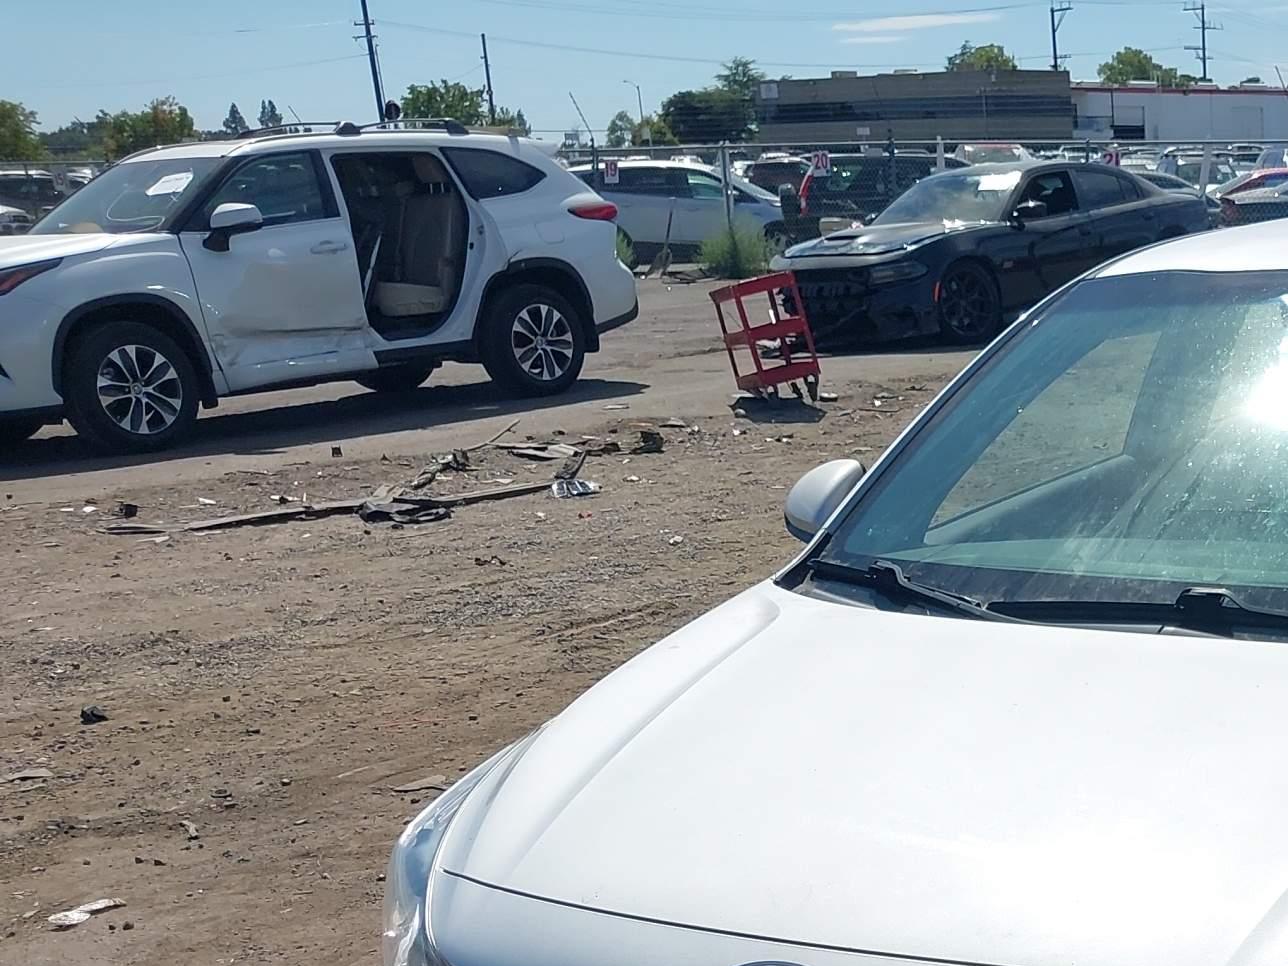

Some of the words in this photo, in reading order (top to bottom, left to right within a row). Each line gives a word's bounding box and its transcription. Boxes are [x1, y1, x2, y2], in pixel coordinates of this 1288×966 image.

[813, 153, 828, 170] 20
[1103, 152, 1120, 167] 21
[606, 161, 617, 177] 19
